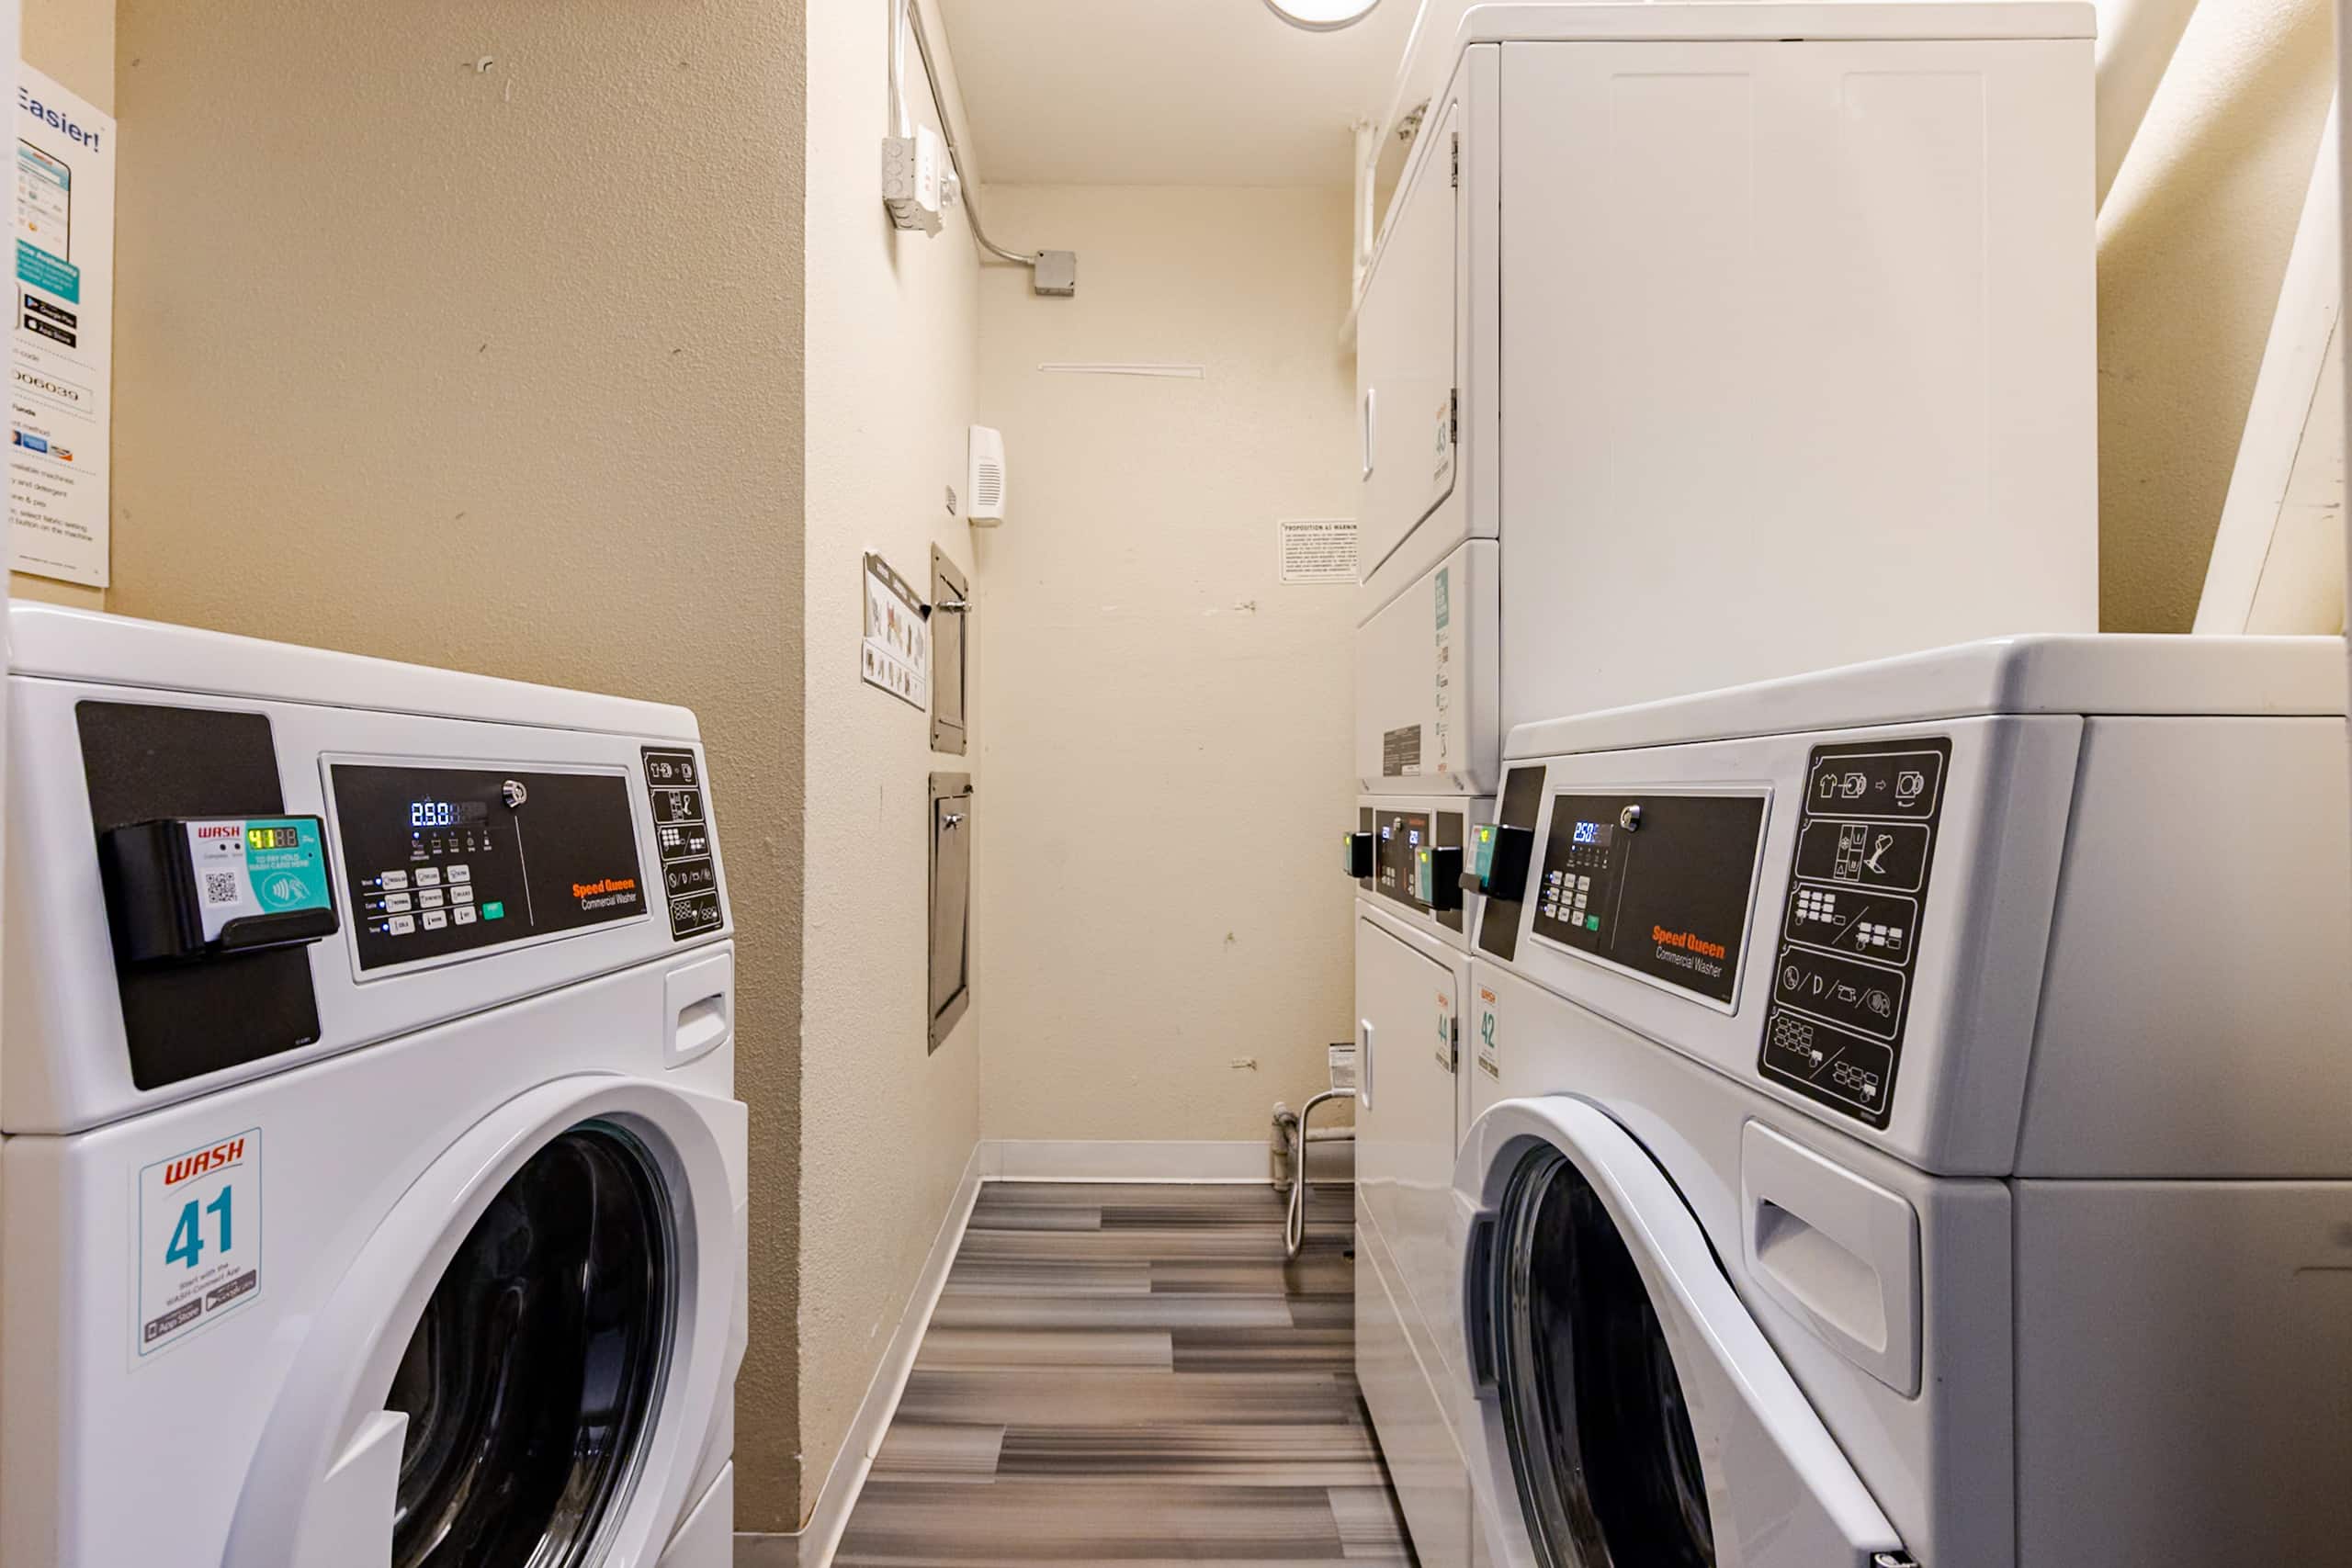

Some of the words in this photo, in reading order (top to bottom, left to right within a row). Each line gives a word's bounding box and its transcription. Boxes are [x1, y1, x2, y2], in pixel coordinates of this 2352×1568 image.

[198, 826, 241, 839] WASH
[249, 829, 275, 850] 41
[572, 879, 605, 897] Speed
[605, 876, 636, 891] Queen
[581, 895, 616, 910] Commercial
[616, 892, 637, 904] Washer
[1652, 925, 1687, 948] Speed
[1688, 933, 1725, 960] Queen
[1656, 946, 1694, 969] Commercial
[1694, 956, 1723, 978] Washer
[1480, 1010, 1496, 1048] 42
[164, 1138, 245, 1186] WASH
[165, 1185, 232, 1269] 41
